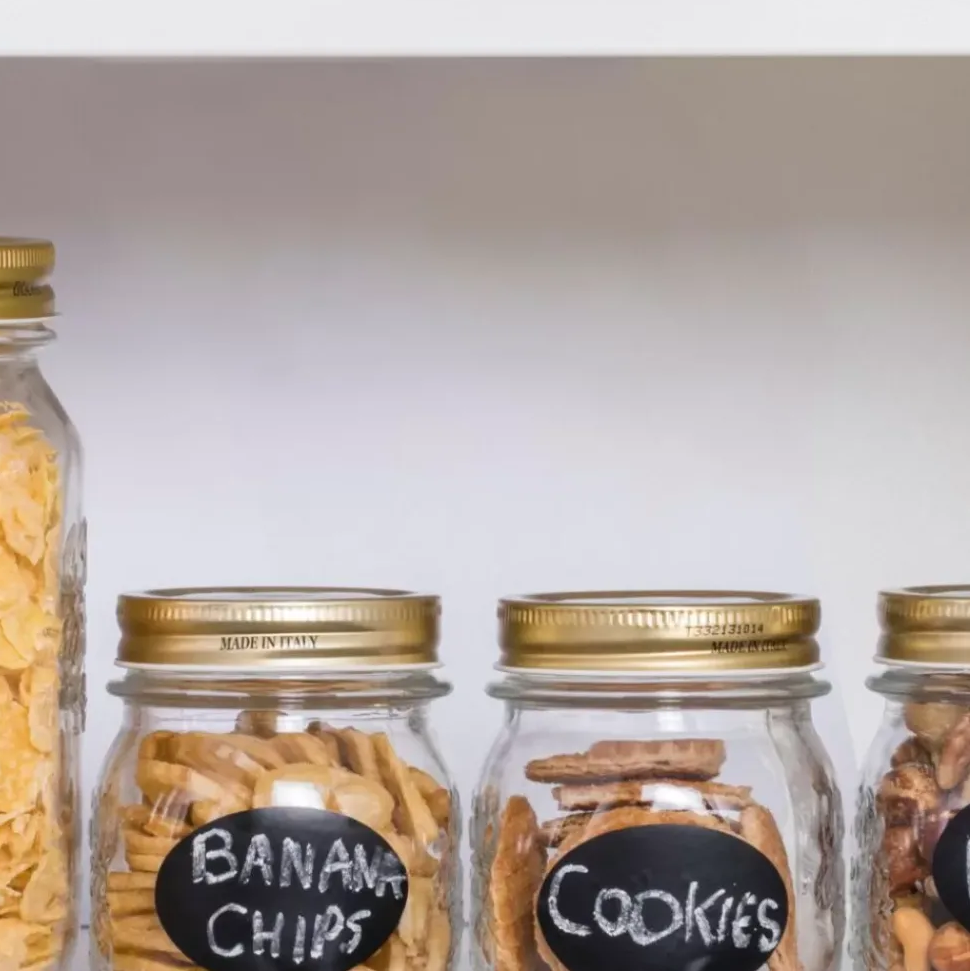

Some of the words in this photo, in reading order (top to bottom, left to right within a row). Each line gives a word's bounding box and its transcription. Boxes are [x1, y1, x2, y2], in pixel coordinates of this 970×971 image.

[219, 635, 259, 651] MADE
[261, 635, 276, 650] IN
[279, 634, 319, 649] ITALY
[711, 640, 747, 654] MADE
[748, 640, 760, 653] IN
[191, 828, 408, 899] BANANA
[206, 903, 372, 965] CHIPS
[548, 863, 782, 953] COOKIES
